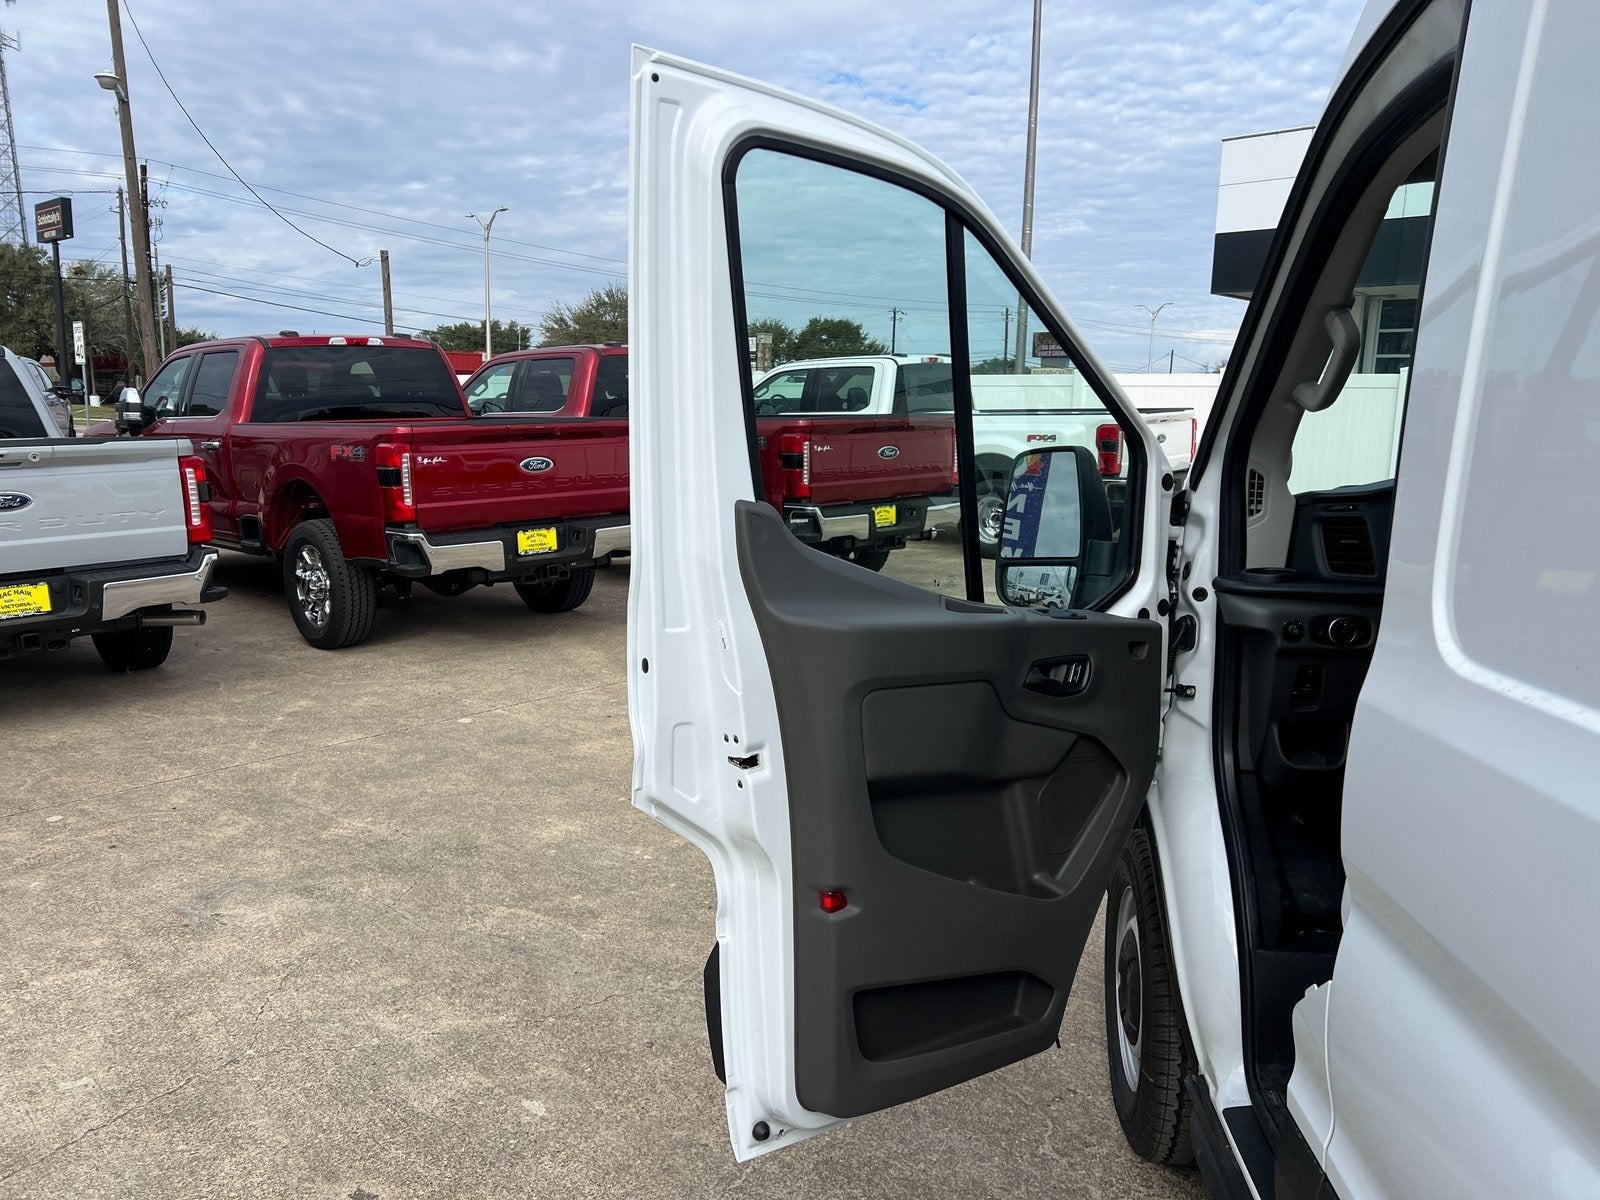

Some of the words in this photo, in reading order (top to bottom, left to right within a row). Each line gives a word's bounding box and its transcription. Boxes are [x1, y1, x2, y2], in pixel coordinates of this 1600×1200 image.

[76, 344, 84, 359] 40
[1026, 434, 1057, 442] FX4
[330, 444, 365, 460] FX4
[432, 480, 547, 497] SUPER
[554, 472, 629, 487] DUTY
[38, 508, 167, 530] DUTY
[13, 589, 32, 597] HAIK
[1, 601, 32, 610] VICTORIA
